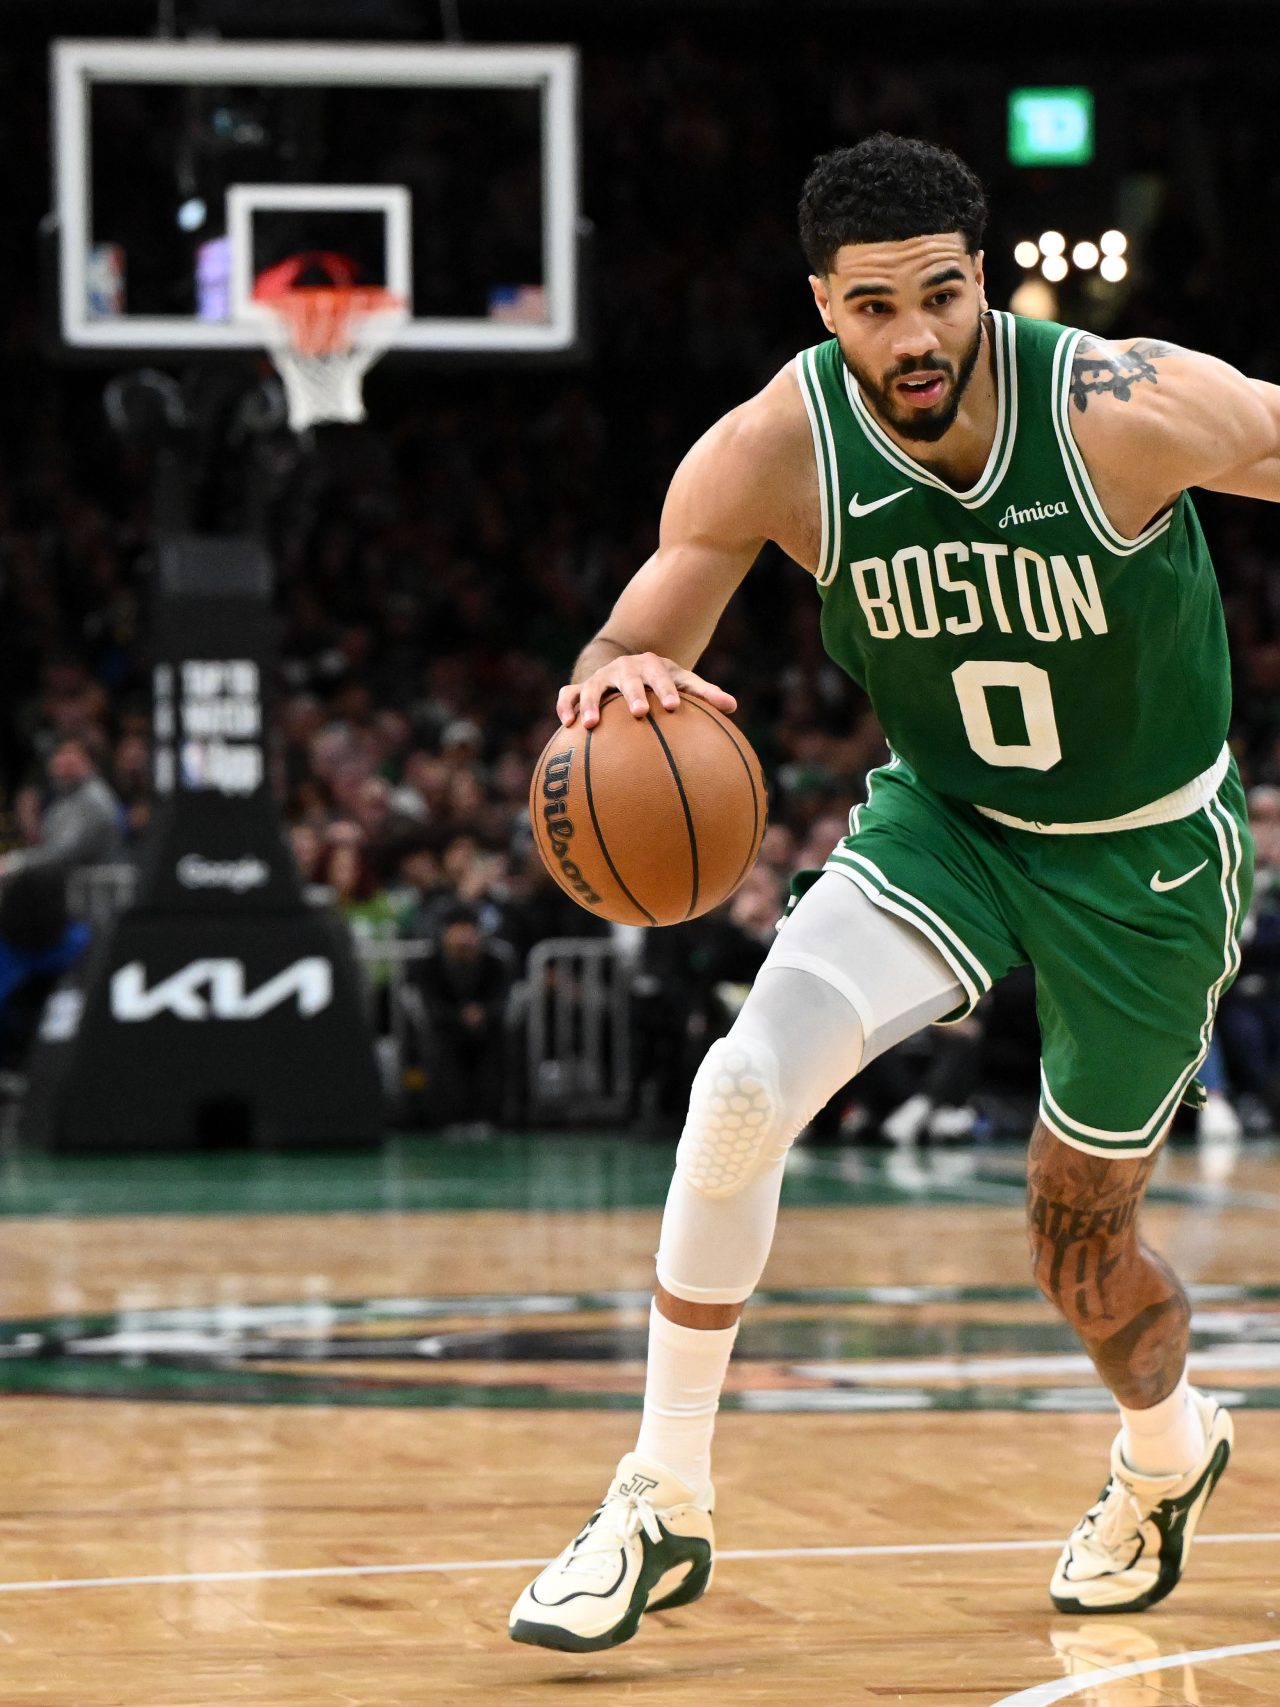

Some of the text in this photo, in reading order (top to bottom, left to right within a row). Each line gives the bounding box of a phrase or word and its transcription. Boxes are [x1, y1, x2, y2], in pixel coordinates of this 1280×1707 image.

[1013, 97, 1088, 153] TD
[998, 500, 1069, 529] Amica
[850, 541, 1109, 642] BOSTON
[951, 660, 1062, 772] 0
[543, 746, 603, 905] Wilson
